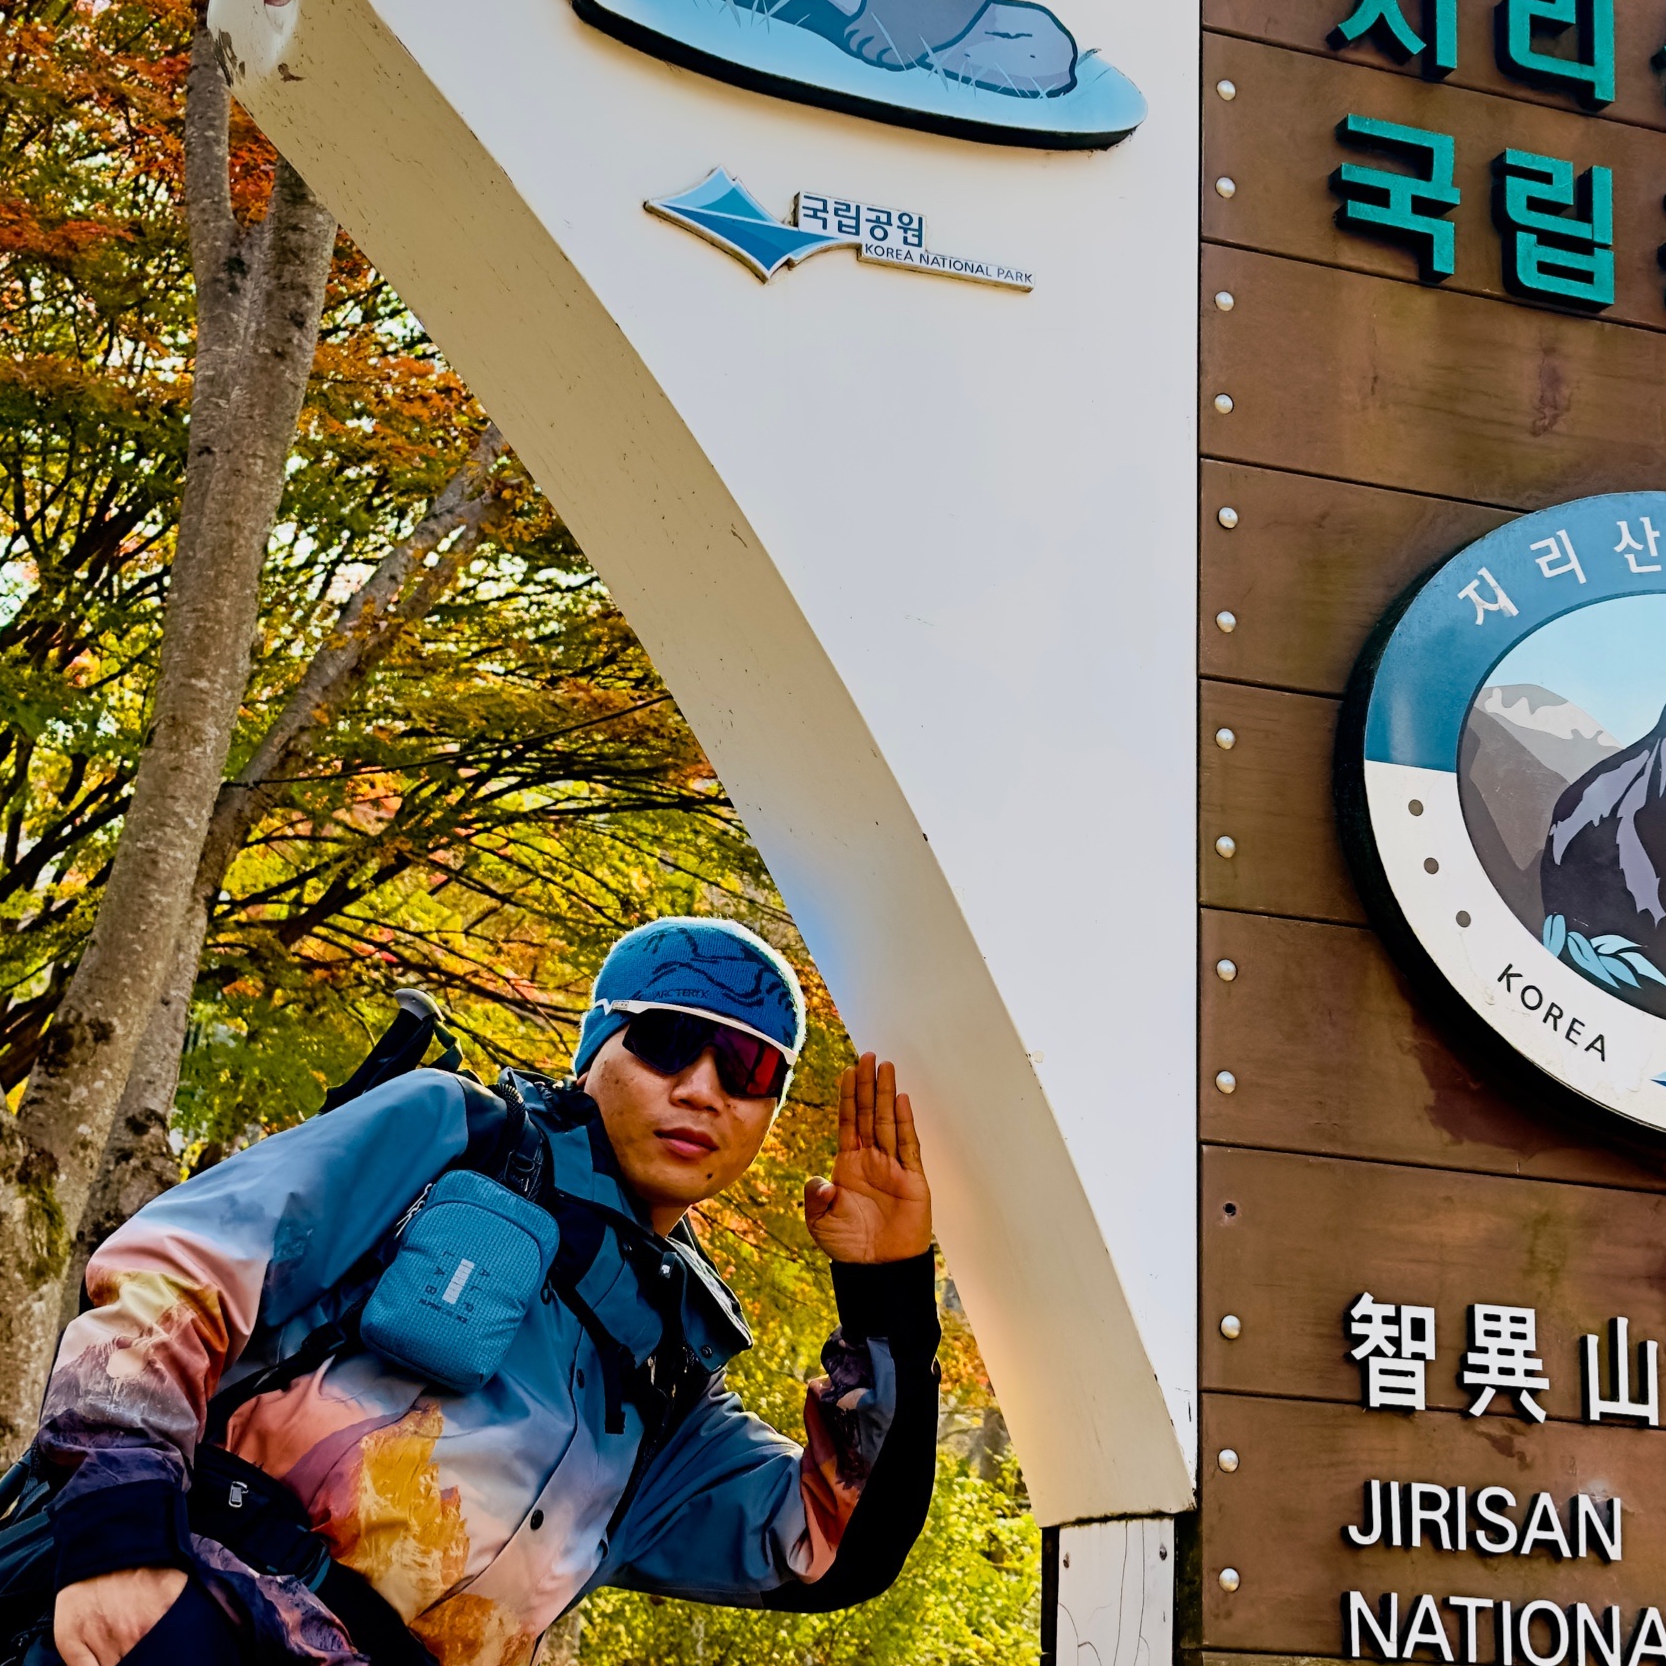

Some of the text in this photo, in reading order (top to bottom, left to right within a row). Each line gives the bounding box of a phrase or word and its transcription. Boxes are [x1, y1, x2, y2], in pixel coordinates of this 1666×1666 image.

[801, 194, 924, 249] 국립공원
[864, 243, 1033, 284] KOREA NATIONAL PARK
[1496, 962, 1608, 1063] KOREA
[1347, 1478, 1623, 1562] JIRISAN
